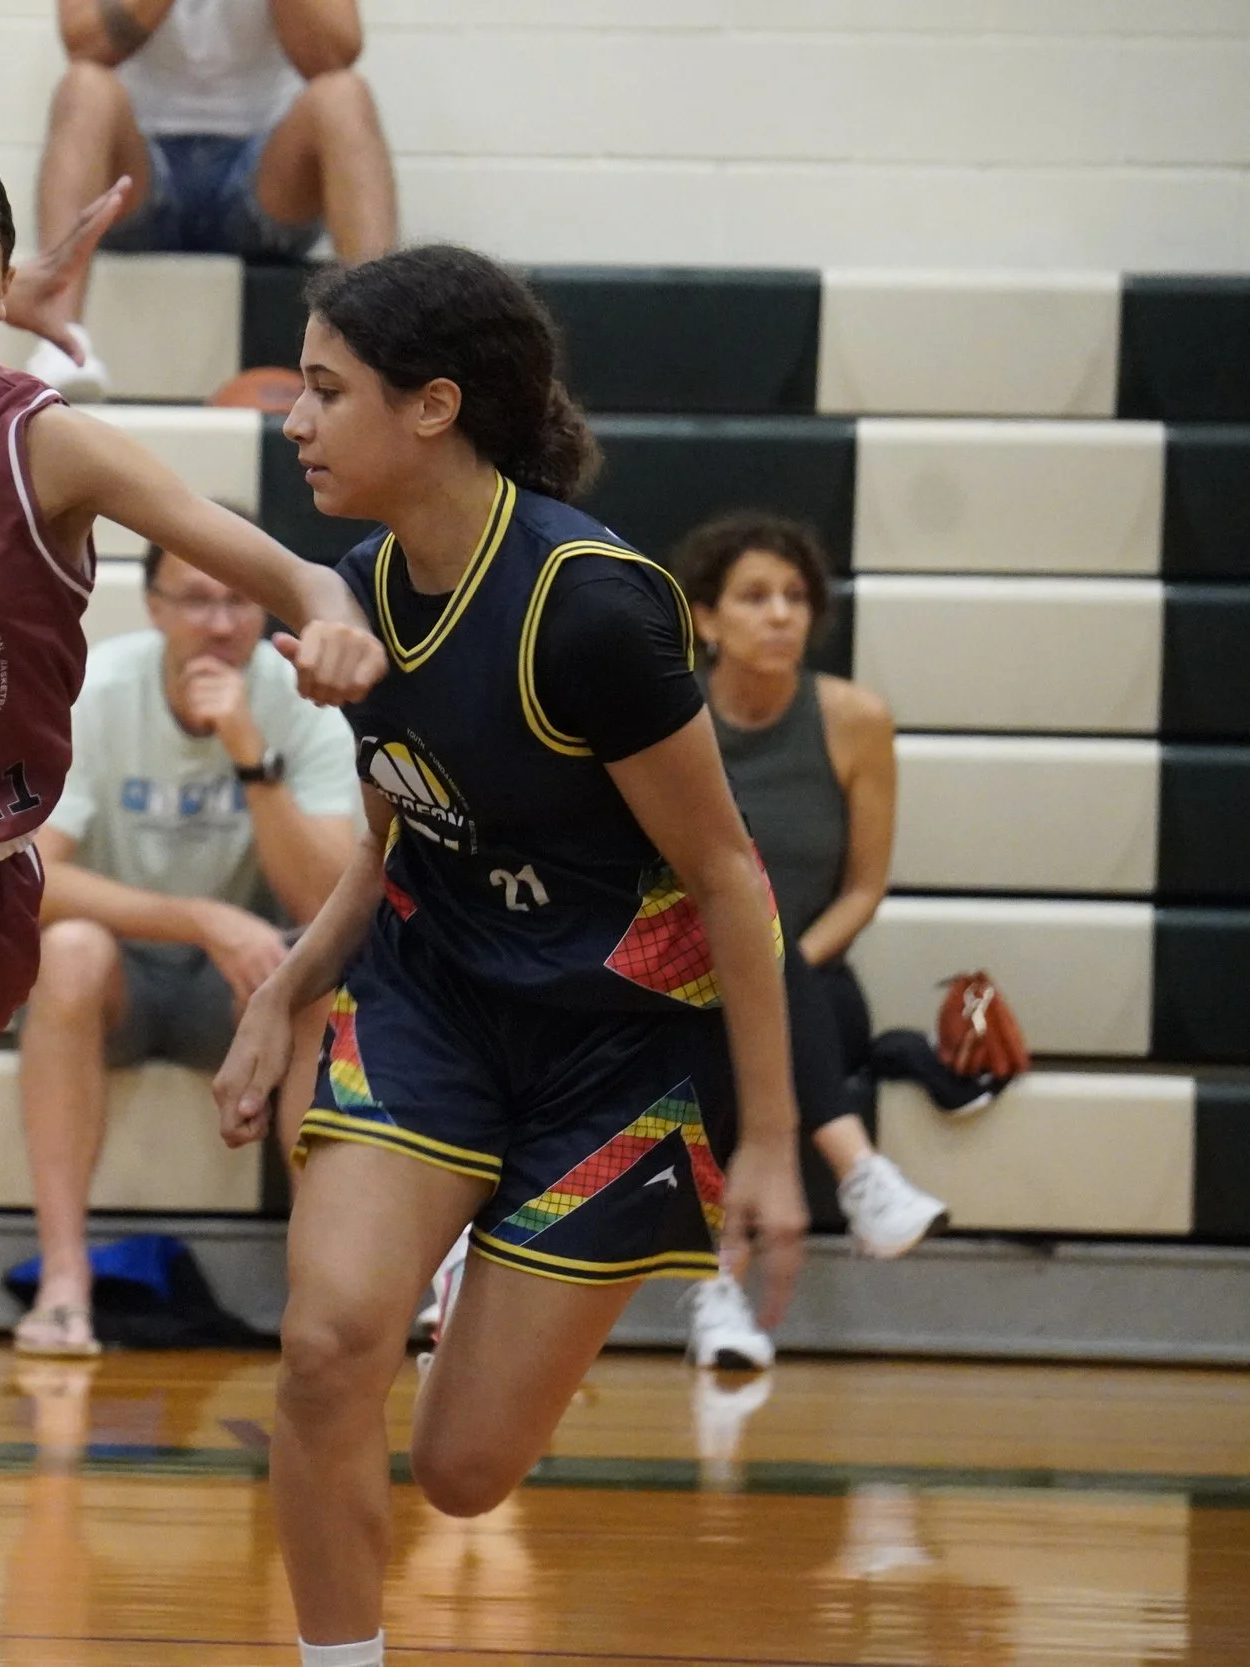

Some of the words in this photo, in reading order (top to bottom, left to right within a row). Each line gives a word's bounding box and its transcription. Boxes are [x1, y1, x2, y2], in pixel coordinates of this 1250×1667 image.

[406, 727, 426, 750] YOUTH
[429, 751, 470, 812] FUNDAMENT
[490, 863, 550, 912] 21
